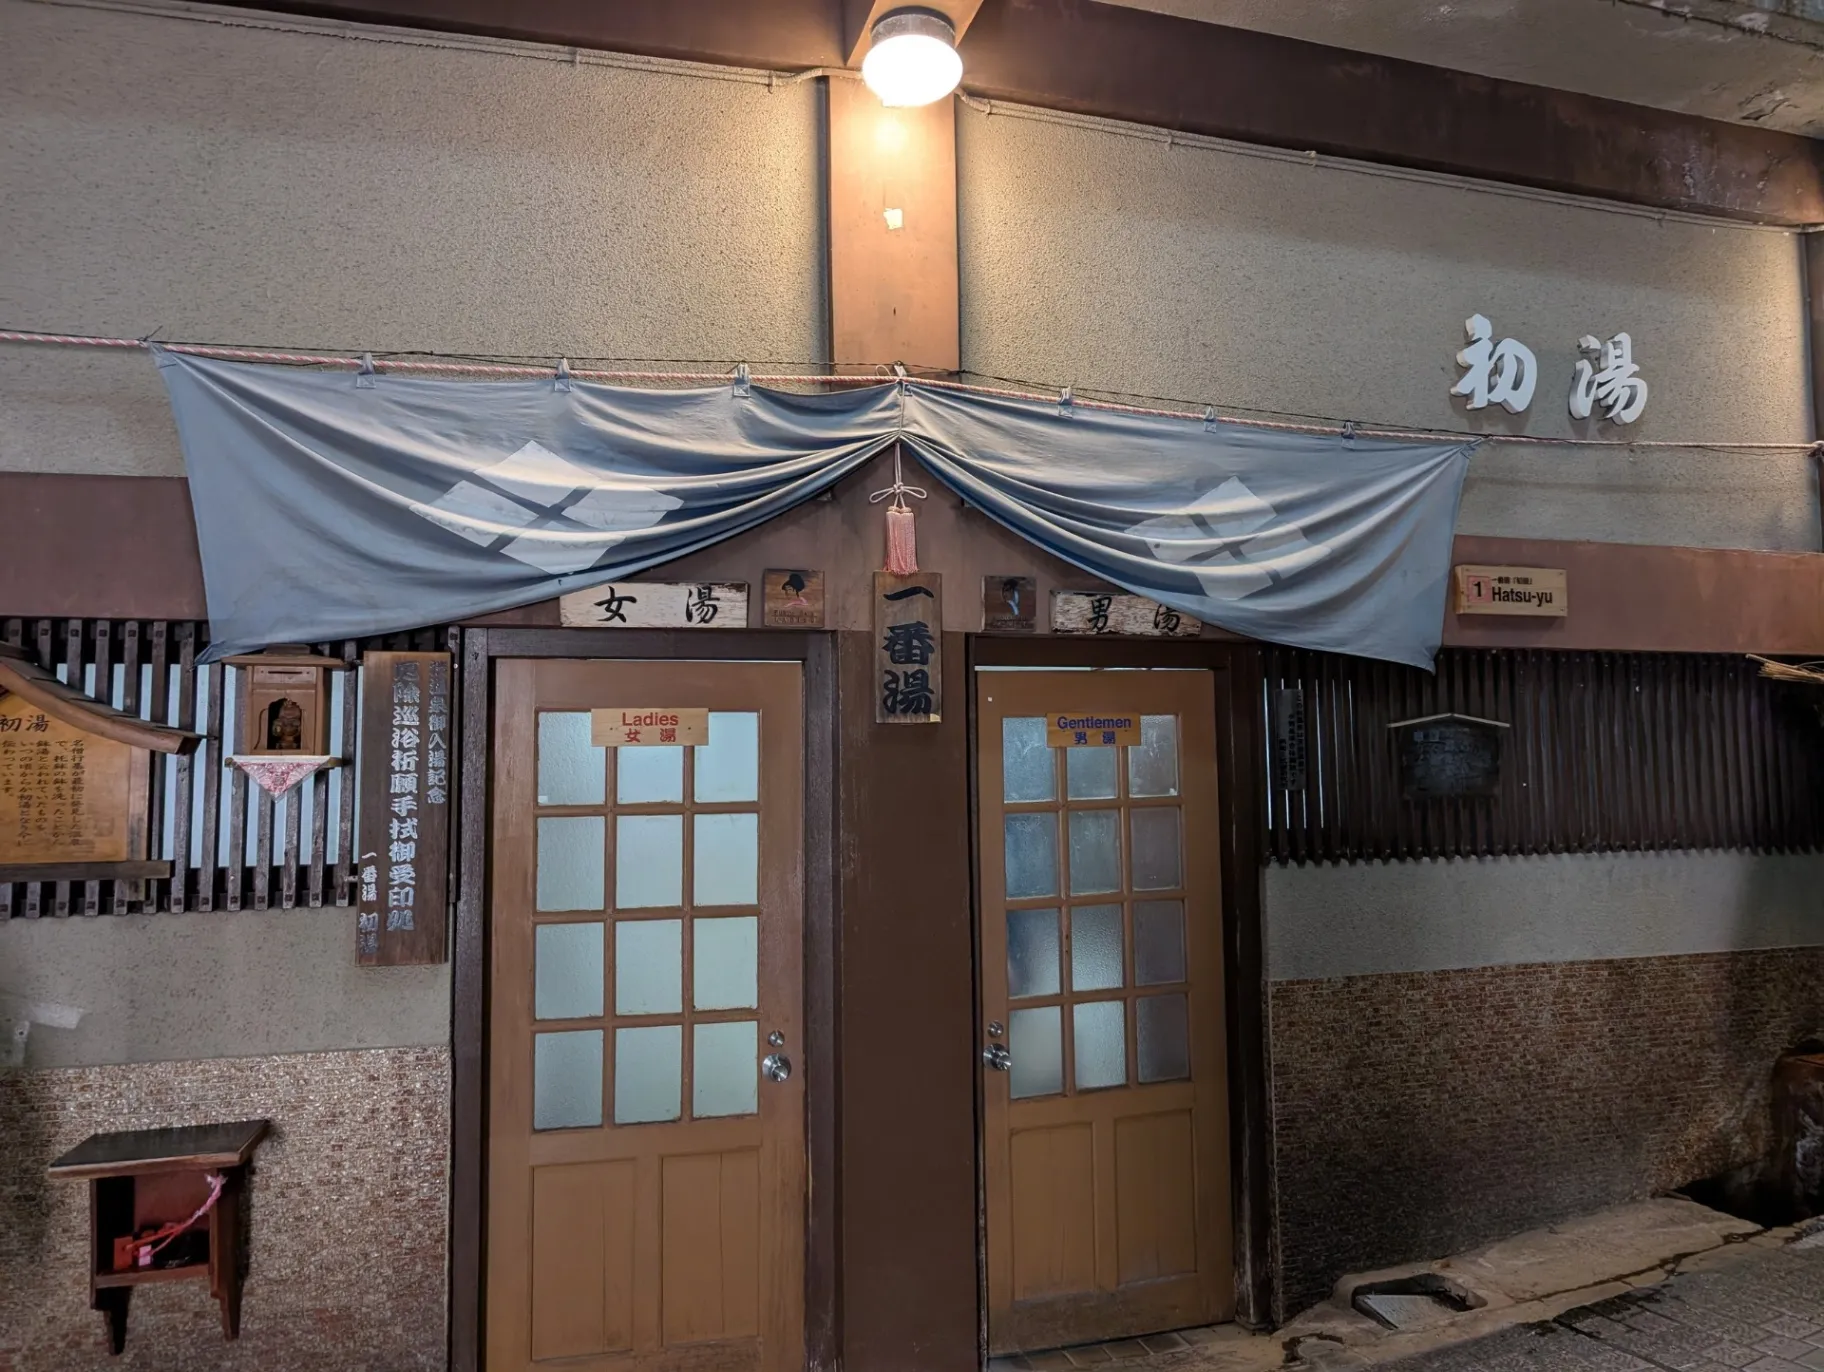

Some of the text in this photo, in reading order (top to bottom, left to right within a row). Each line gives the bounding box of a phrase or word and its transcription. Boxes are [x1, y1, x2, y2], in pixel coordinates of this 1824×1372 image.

[1450, 314, 1647, 425] 初湯
[594, 586, 720, 624] 女湯
[1473, 581, 1553, 607] 1 Hatsu-yu
[1088, 596, 1181, 632] 男湯
[882, 586, 934, 714] 一番湯
[0, 714, 50, 732] 初湯
[622, 712, 679, 726] Ladies
[1057, 716, 1132, 730] Gentlemen
[624, 728, 677, 743] 女湯
[1074, 731, 1116, 745] 男湯
[359, 851, 379, 954] 一番湯 初湯
